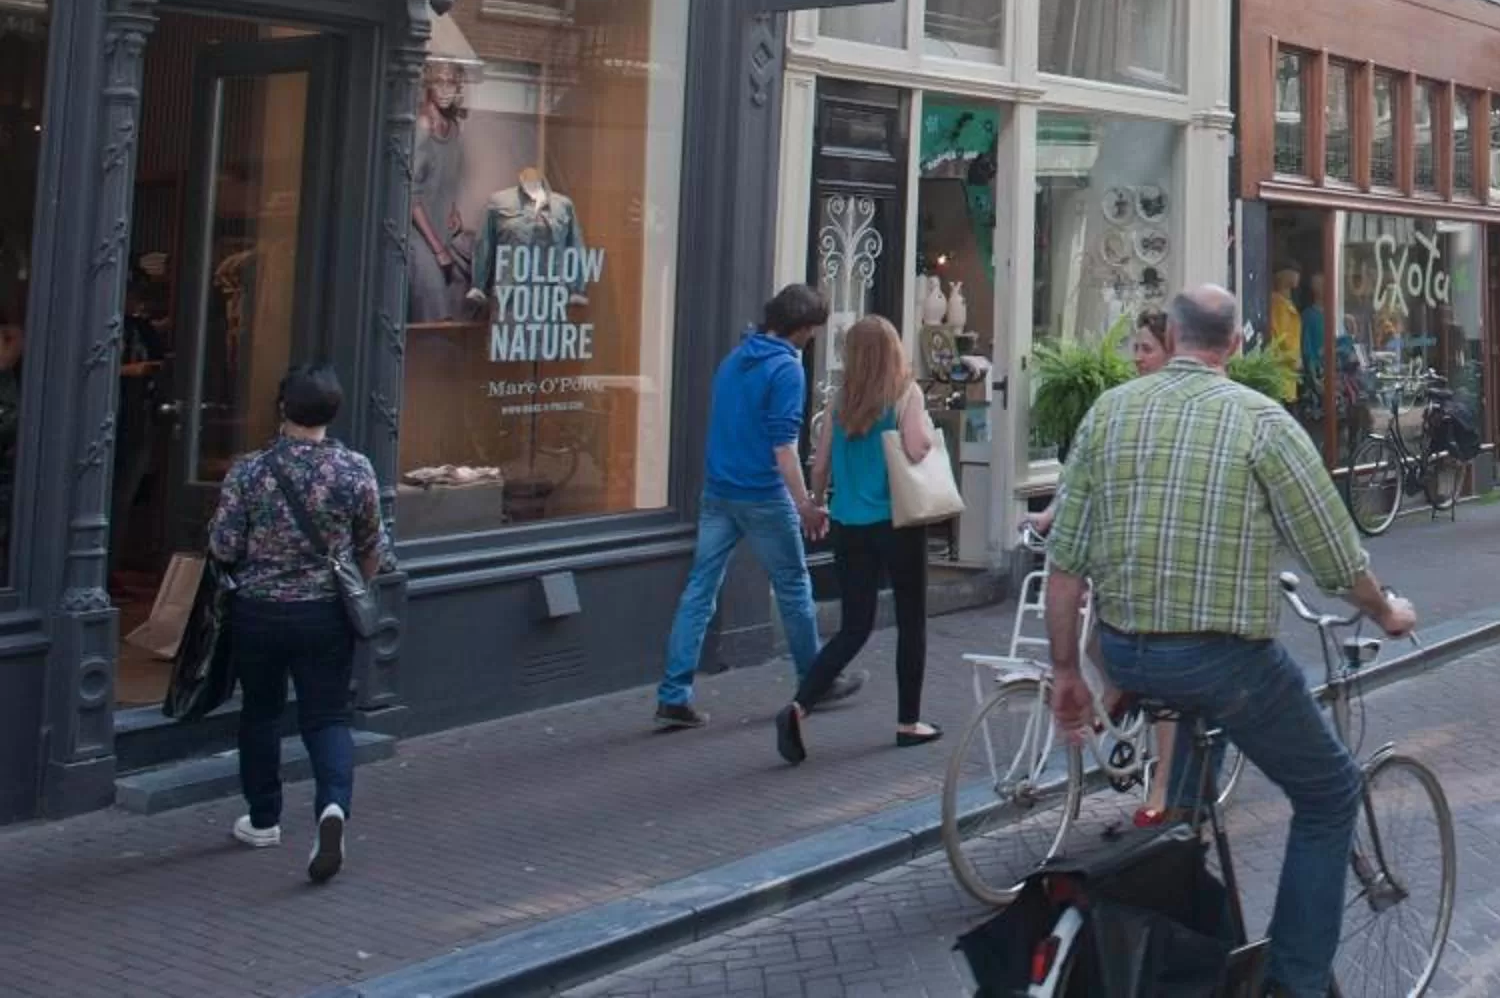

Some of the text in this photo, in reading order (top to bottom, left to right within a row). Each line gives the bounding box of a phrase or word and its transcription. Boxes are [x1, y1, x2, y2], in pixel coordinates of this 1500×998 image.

[495, 245, 606, 284] FOLLOW
[495, 285, 569, 323] YOUR
[489, 323, 594, 362] NATURE
[487, 380, 538, 397] Marc
